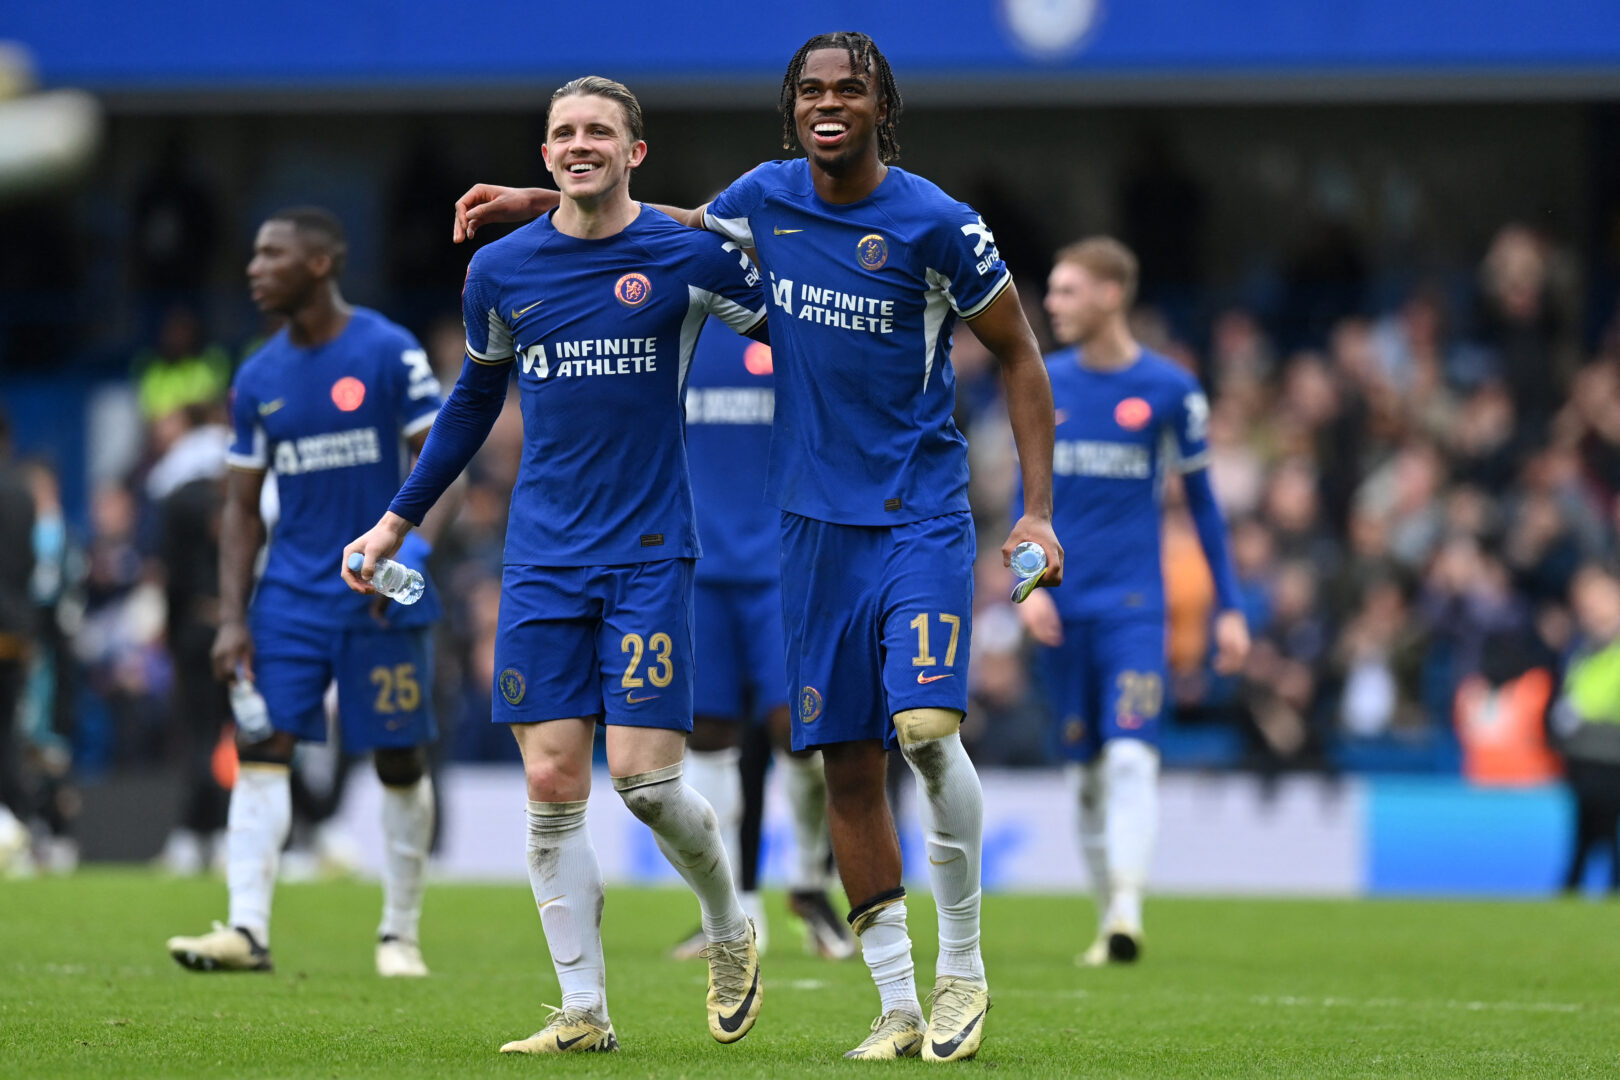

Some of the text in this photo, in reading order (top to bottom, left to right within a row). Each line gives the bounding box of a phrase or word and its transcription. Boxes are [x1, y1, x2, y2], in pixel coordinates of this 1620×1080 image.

[976, 245, 1000, 276] Bing
[744, 266, 760, 288] Bi
[801, 284, 895, 316] INFINITE
[798, 304, 893, 334] ATHLETE
[556, 337, 657, 358] INFINITE
[557, 355, 657, 377] ATHLETE
[910, 613, 961, 667] 17
[621, 632, 674, 688] 23
[370, 663, 420, 713] 25
